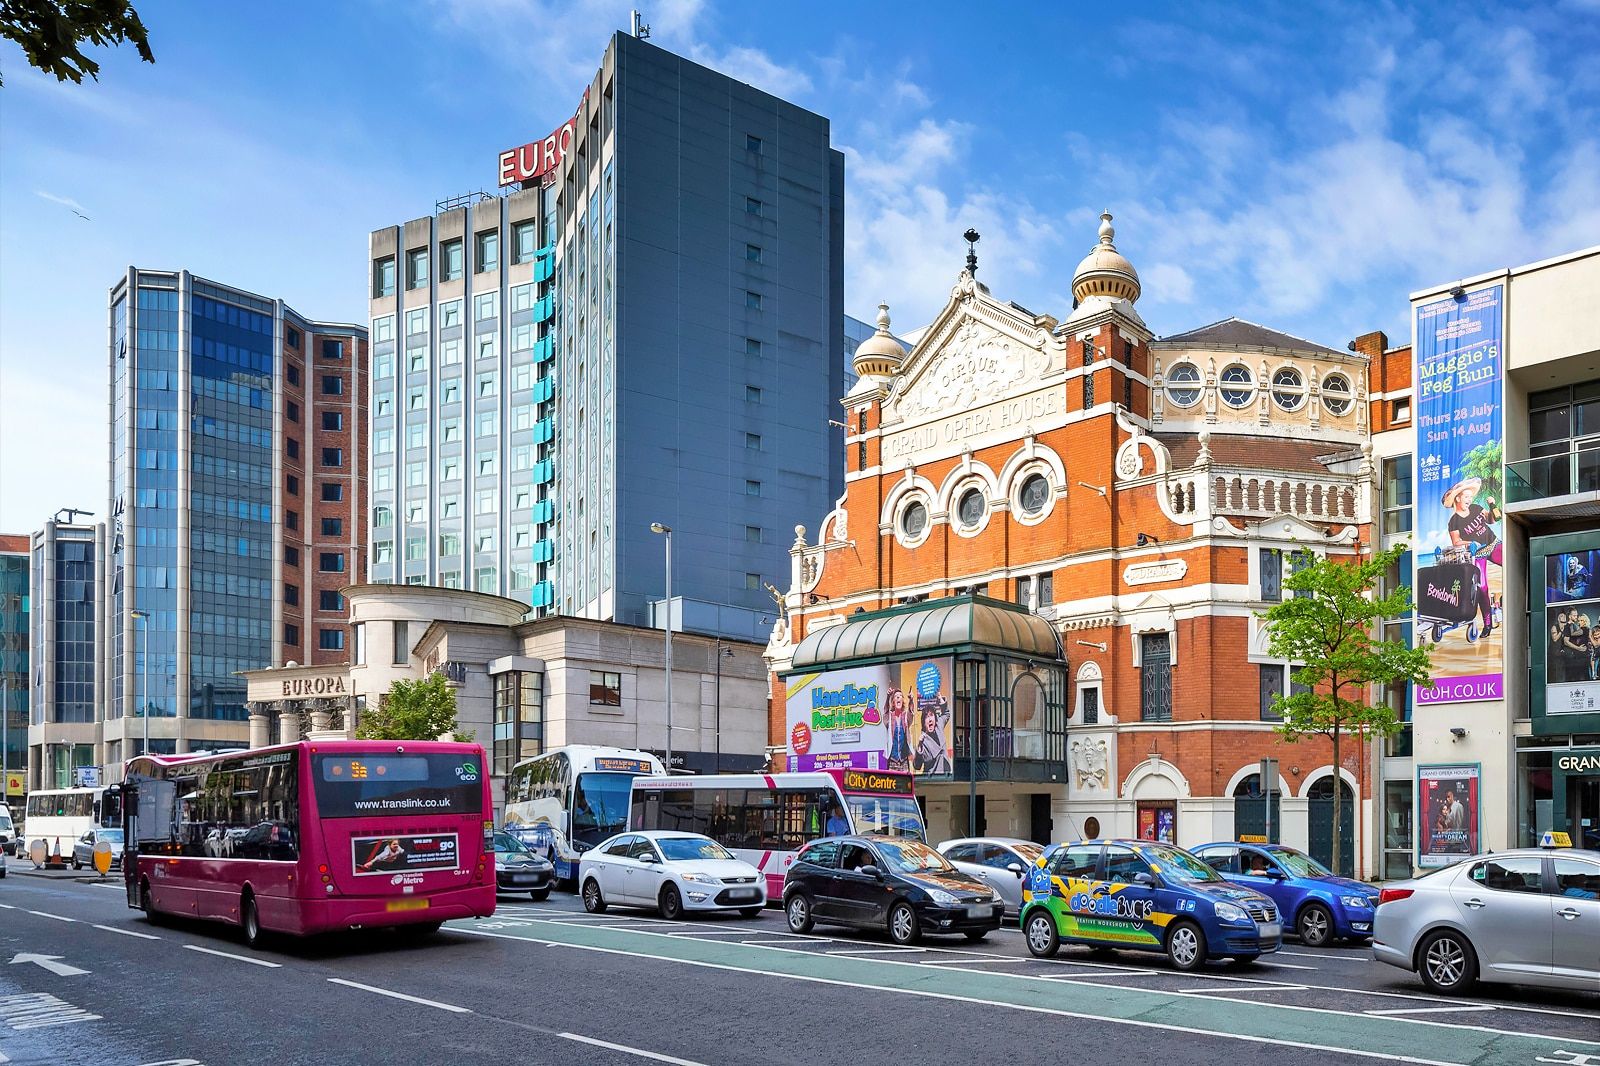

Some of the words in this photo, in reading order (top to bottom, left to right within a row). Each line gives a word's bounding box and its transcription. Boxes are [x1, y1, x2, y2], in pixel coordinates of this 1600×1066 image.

[500, 110, 581, 186] EURO
[1419, 345, 1498, 380] Maggie's
[1421, 375, 1453, 397] Feg
[1457, 365, 1495, 387] Run
[892, 430, 937, 458] GRAND
[944, 411, 995, 444] OPERA
[1001, 392, 1058, 429] HOUSE
[1418, 411, 1450, 428] Thurs
[1426, 428, 1448, 444] Sun
[1452, 425, 1465, 437] 14
[1468, 421, 1491, 436] Aug
[1427, 582, 1457, 606] Benidorm
[282, 676, 346, 696] EUROPA
[1420, 682, 1496, 700] GOH.CO.UK
[811, 683, 878, 709] Handbag
[811, 708, 864, 732] Positive
[455, 766, 464, 776] go
[460, 773, 477, 781] eco
[848, 773, 867, 789] City
[868, 775, 897, 790] Centre
[355, 798, 450, 810] www.translink.co.uk
[440, 841, 454, 851] go
[403, 876, 424, 884] Metro
[1098, 920, 1129, 929] WORKSHOPS
